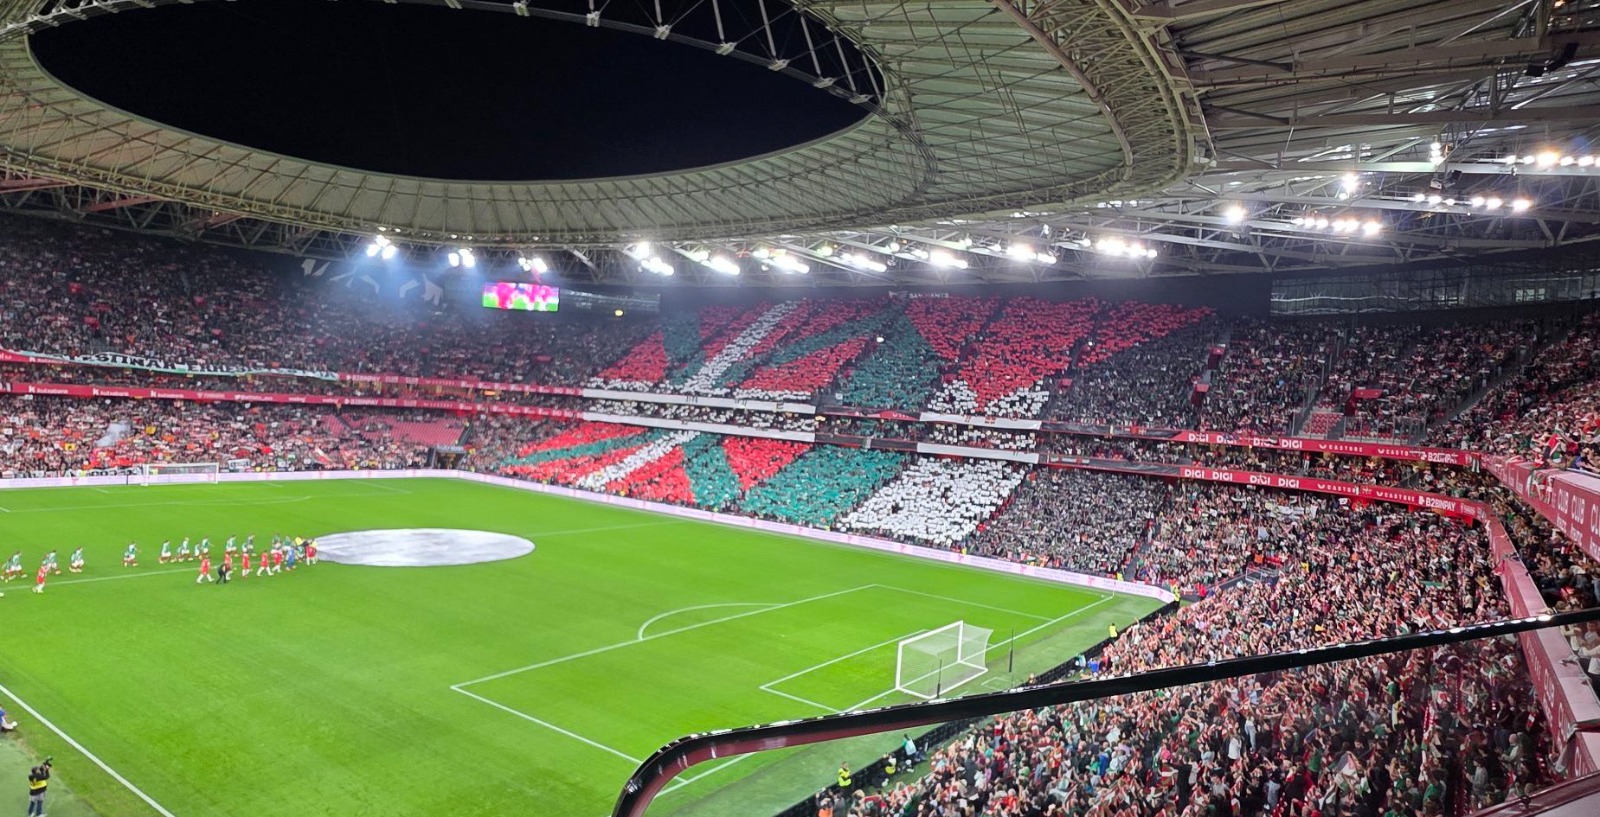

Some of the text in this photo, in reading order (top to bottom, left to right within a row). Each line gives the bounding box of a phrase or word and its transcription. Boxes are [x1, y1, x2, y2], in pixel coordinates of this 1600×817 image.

[1282, 439, 1302, 449] DIGI
[1328, 445, 1363, 453] CASTORE
[1184, 469, 1204, 478] DIGI
[1212, 471, 1232, 481] DIGI
[1250, 475, 1270, 485] DIGI
[1278, 478, 1299, 488] DIGI
[1384, 492, 1415, 502] CASTORE
[1426, 497, 1457, 511] B2BINPAY
[1571, 495, 1585, 525] CLUB
